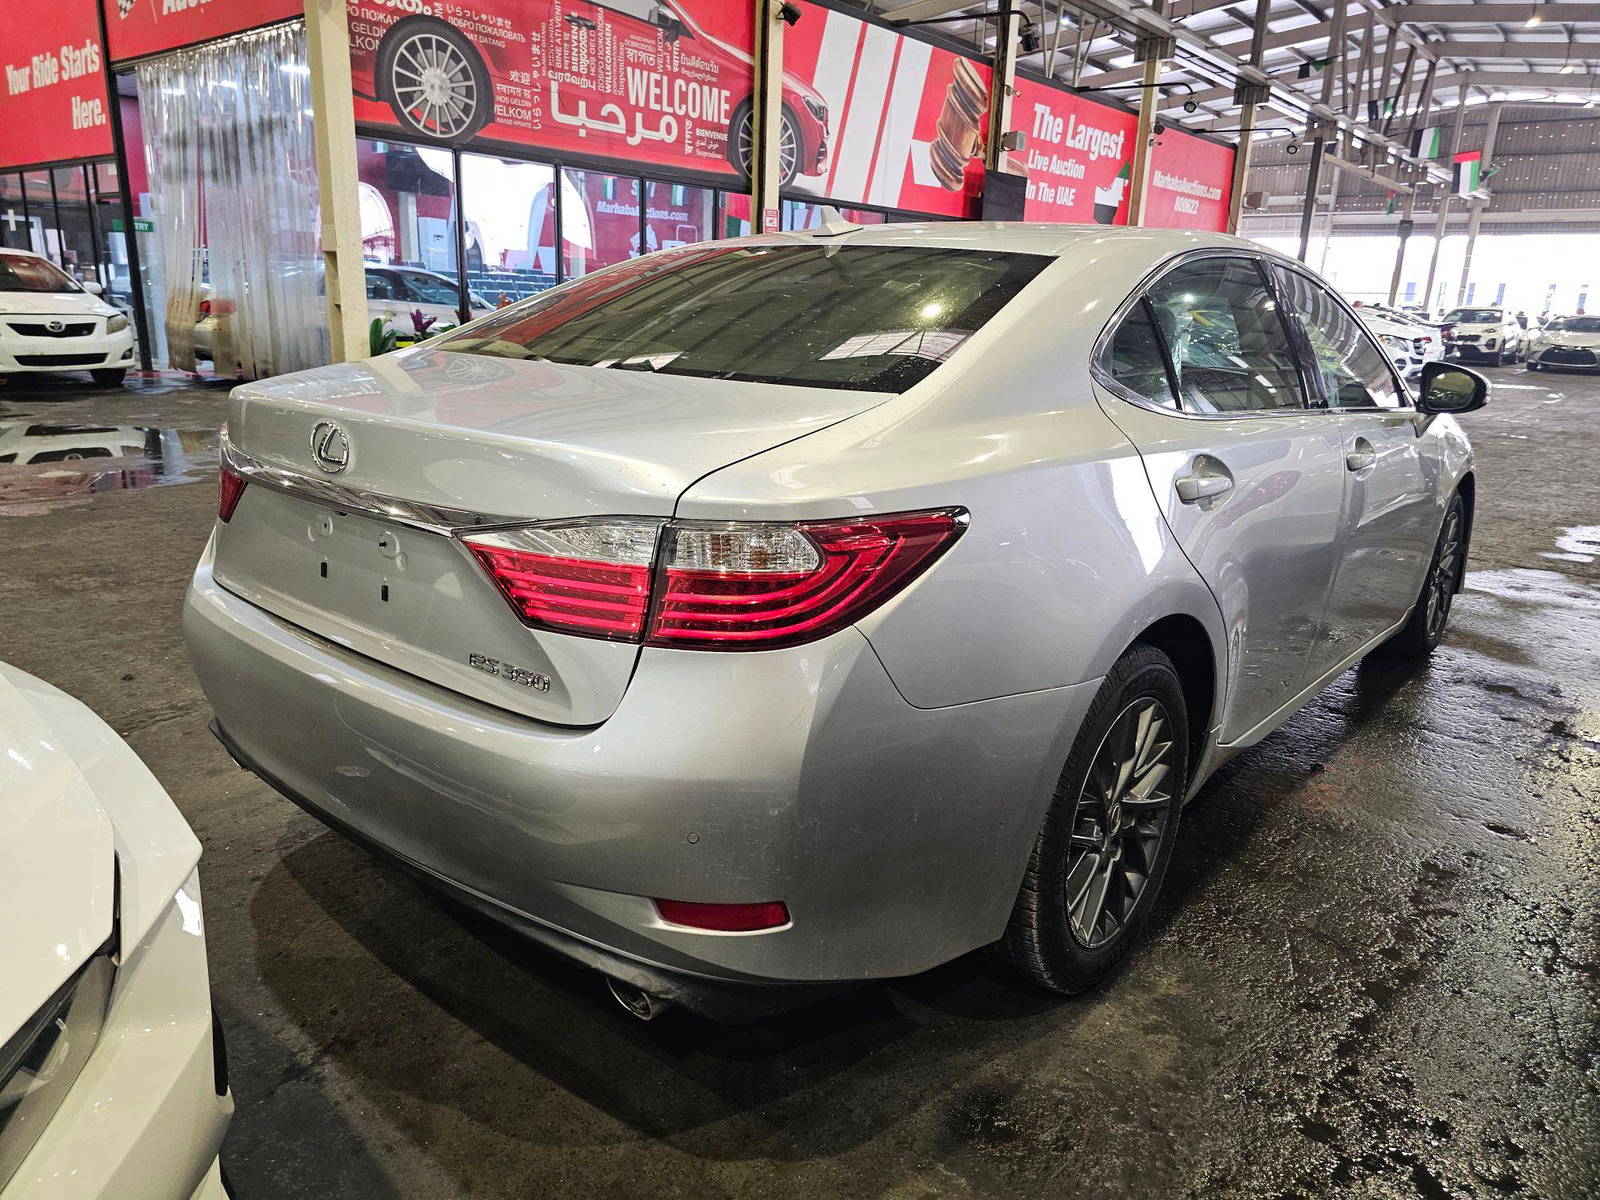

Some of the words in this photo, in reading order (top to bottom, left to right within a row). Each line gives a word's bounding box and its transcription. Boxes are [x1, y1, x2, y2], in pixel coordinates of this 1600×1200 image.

[571, 11, 579, 72] BIENVENE
[604, 23, 612, 94] WILLKOMMEN
[5, 64, 30, 95] Your
[32, 51, 59, 88] Ride
[61, 39, 100, 81] Starts
[71, 95, 107, 130] Here.
[494, 104, 532, 120] ELKOM
[550, 81, 678, 146] مرحبا
[626, 66, 730, 125] WELCOME
[1032, 102, 1064, 144] The
[1065, 114, 1125, 161] Largest
[1027, 149, 1049, 172] Live
[1048, 154, 1086, 179] Auction
[1038, 181, 1055, 203] The
[1056, 186, 1076, 207] UAE
[1152, 169, 1222, 201] MarhabaAuctions.com
[134, 222, 149, 231] TRY
[596, 200, 689, 221] Marhabactions.com
[470, 653, 499, 675] ES
[502, 662, 550, 692] 350
